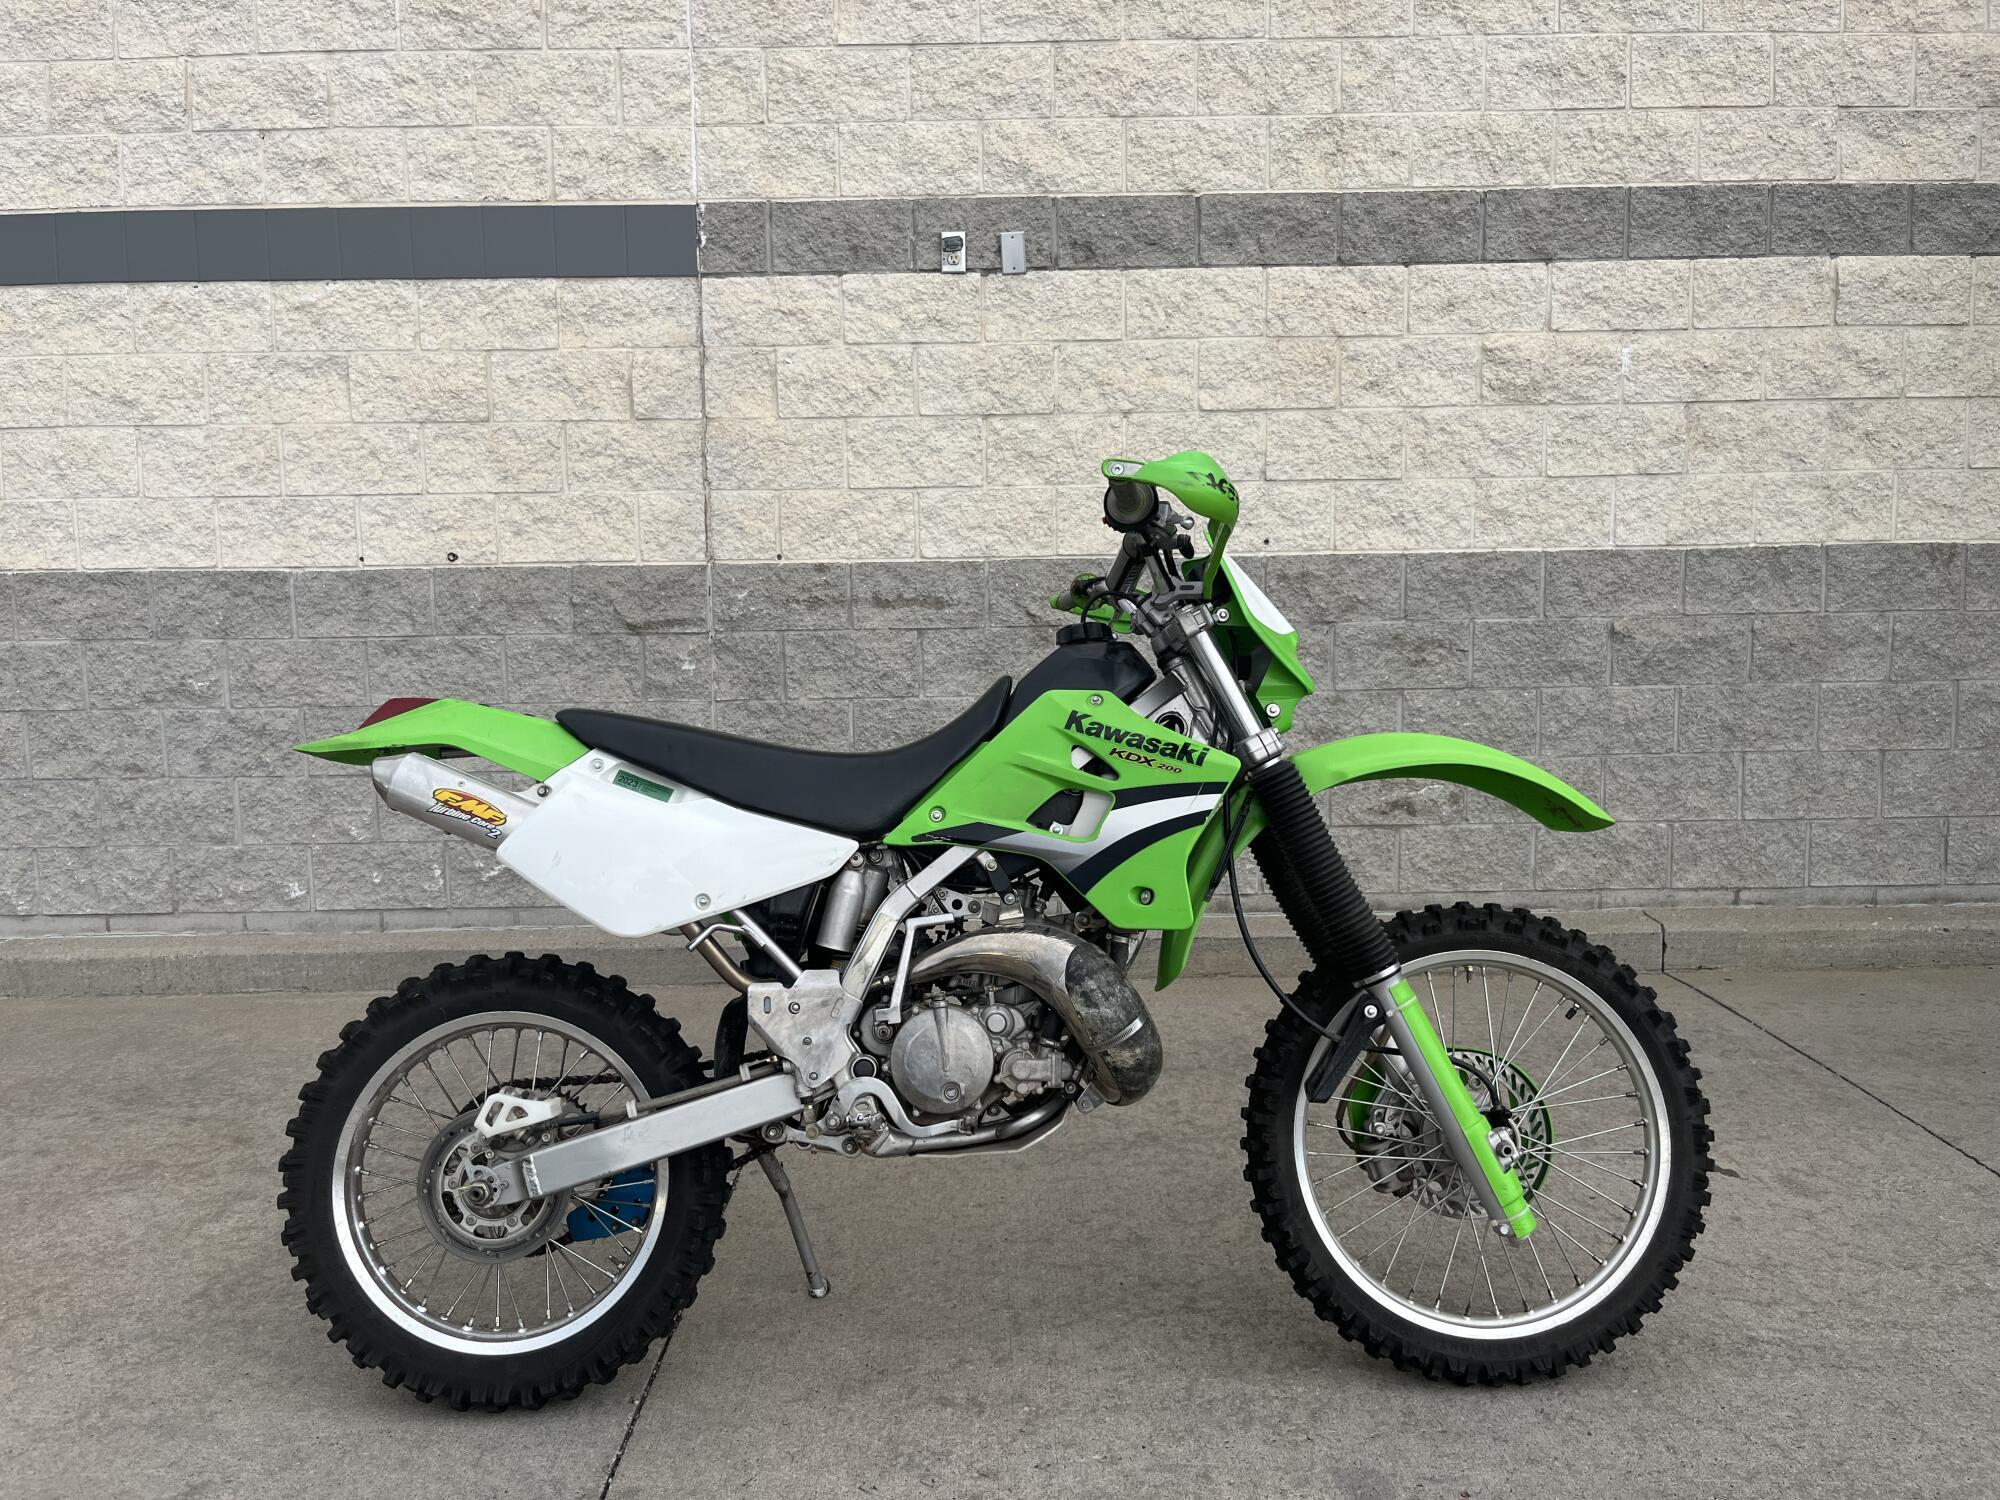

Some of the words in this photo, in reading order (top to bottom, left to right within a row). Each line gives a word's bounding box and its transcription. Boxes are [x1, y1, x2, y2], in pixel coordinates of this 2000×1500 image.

[1064, 710, 1211, 766] Kawasaki
[1108, 748, 1158, 768] KDX
[1157, 763, 1183, 774] 200
[617, 775, 639, 787] 2023
[427, 801, 471, 822] Turbine
[486, 828, 502, 840] 2
[434, 789, 508, 825] FMF
